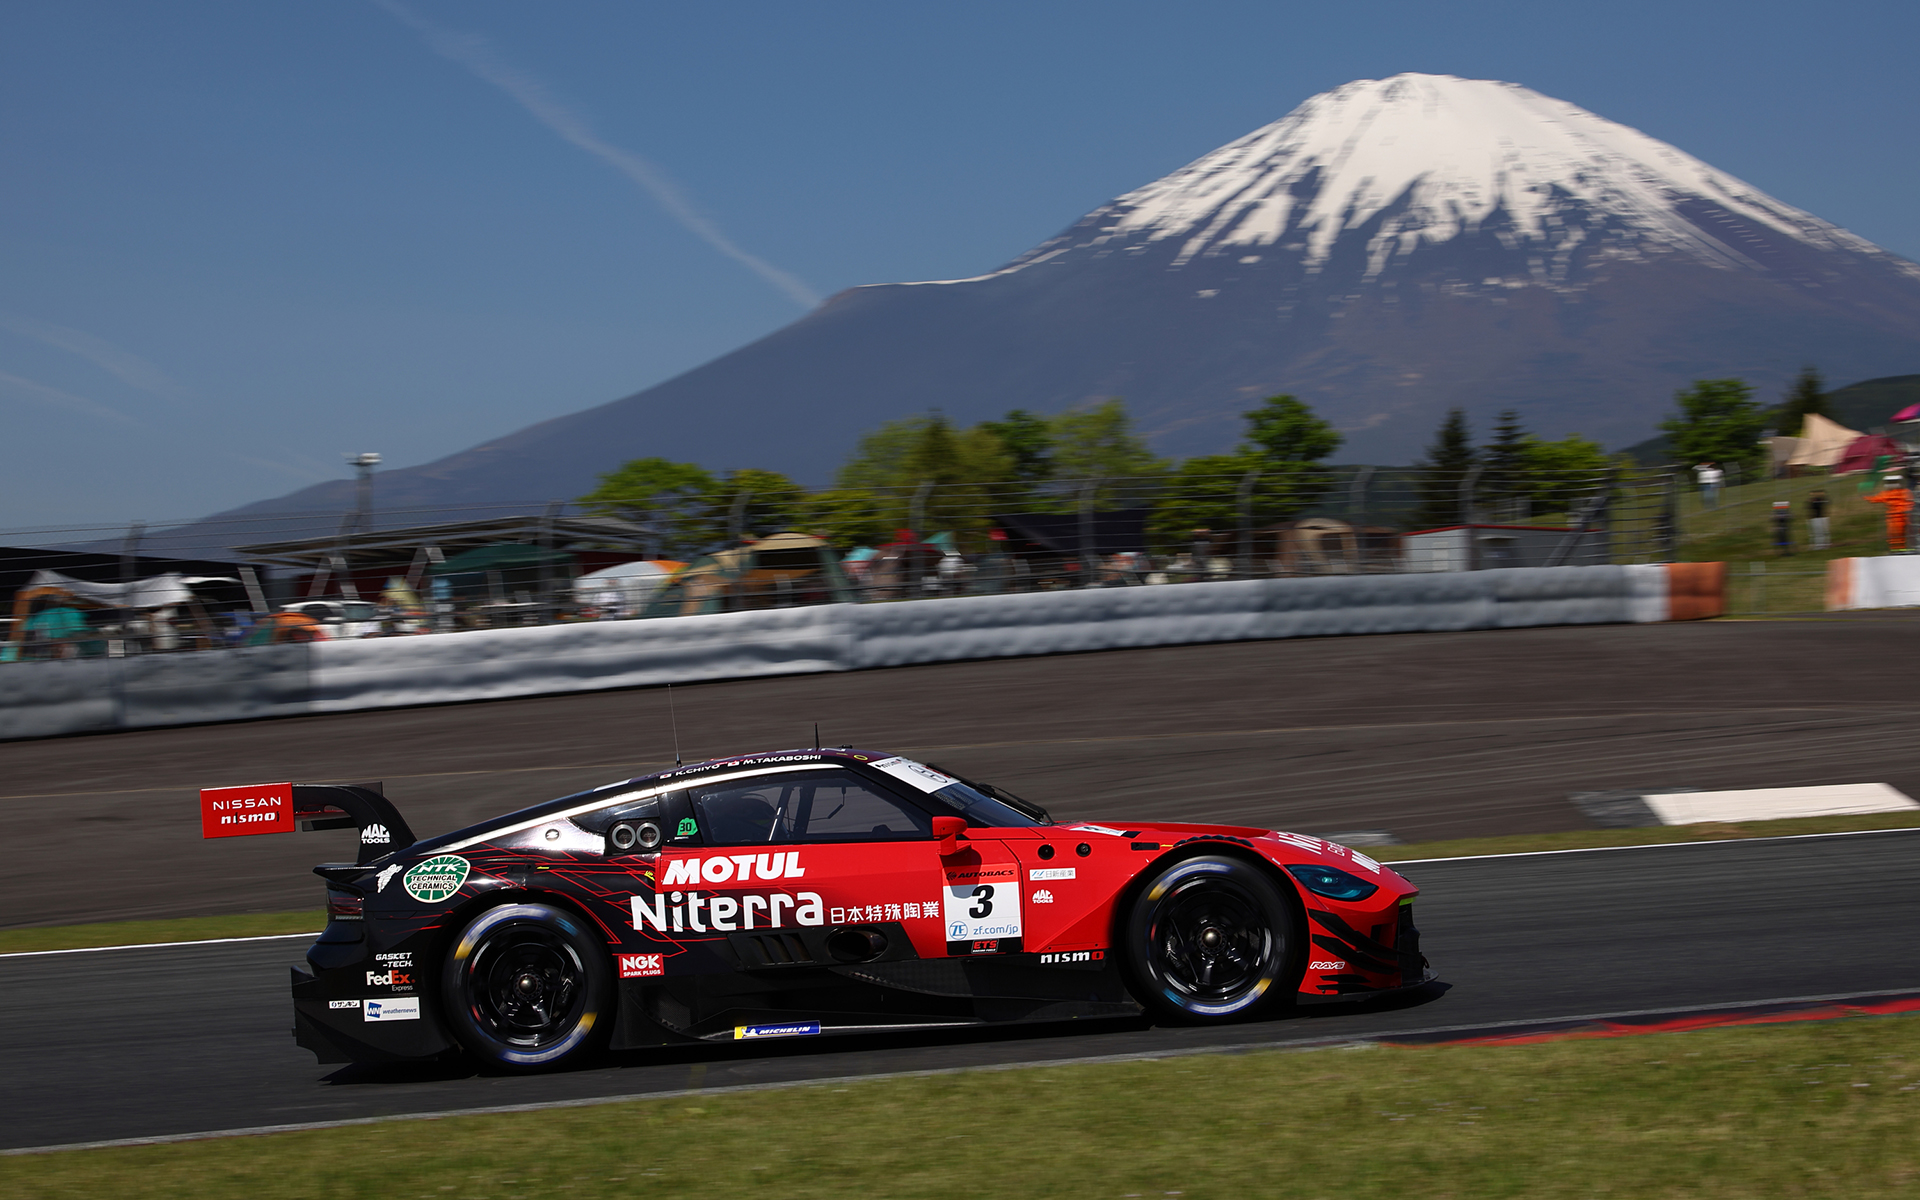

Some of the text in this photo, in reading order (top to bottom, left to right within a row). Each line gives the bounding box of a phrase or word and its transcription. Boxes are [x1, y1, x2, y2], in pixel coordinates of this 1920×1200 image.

[675, 754, 822, 776] K.CHIYO M.TAKABOSHI
[213, 796, 282, 811] NISSAN
[221, 812, 277, 825] nismo
[361, 823, 390, 838] MAC
[680, 822, 692, 832] 30
[417, 863, 461, 873] NTK
[662, 851, 805, 885] MOTUL
[957, 869, 1014, 879] AUTOBACS
[411, 882, 454, 890] CERAMICS
[1032, 889, 1053, 899] MAC
[969, 884, 995, 919] 3
[630, 891, 824, 932] Niterra
[830, 901, 940, 924] 日本特殊陶業
[973, 924, 1019, 935] zf.com/jp
[973, 940, 998, 950] ETS
[375, 952, 412, 961] GASKET
[622, 955, 660, 970] NGK
[1040, 951, 1105, 964] nismo
[1310, 961, 1345, 969] RAYS
[366, 970, 411, 985] FedEx
[759, 1026, 811, 1034] MICHELIN
